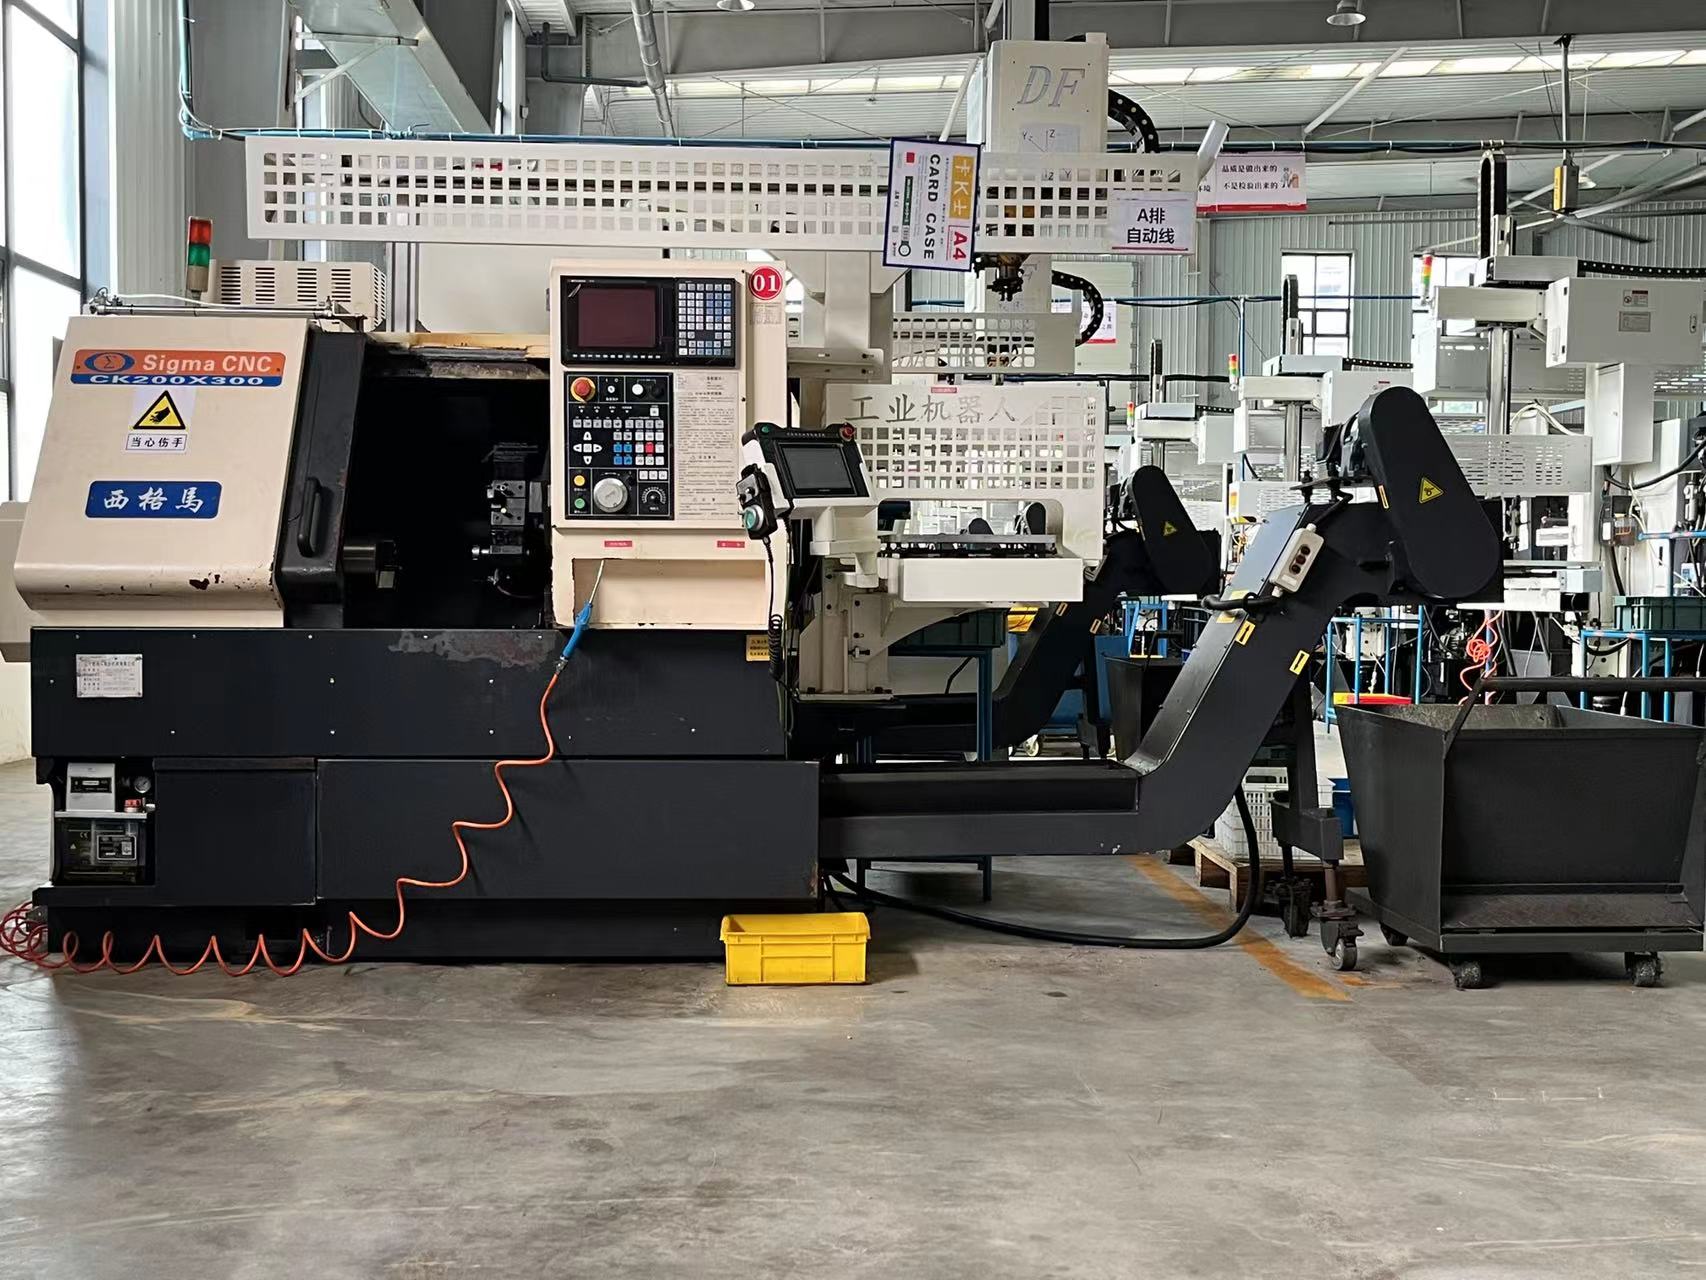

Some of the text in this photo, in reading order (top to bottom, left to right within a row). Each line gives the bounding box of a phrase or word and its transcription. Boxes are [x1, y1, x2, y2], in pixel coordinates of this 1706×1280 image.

[1017, 65, 1086, 108] DF
[1221, 164, 1278, 173] 品质是做出来的
[1223, 182, 1278, 190] 不是检验出来的
[924, 154, 941, 260] CARD CASE
[1136, 207, 1166, 225] A排
[1127, 227, 1175, 245] 自动线
[953, 231, 967, 260] A4
[753, 274, 778, 292] 01
[143, 354, 272, 375] Sigma CNC
[89, 374, 264, 386] CK200X300
[844, 393, 1016, 424] 工业机器人
[130, 436, 184, 448] 当心伤手
